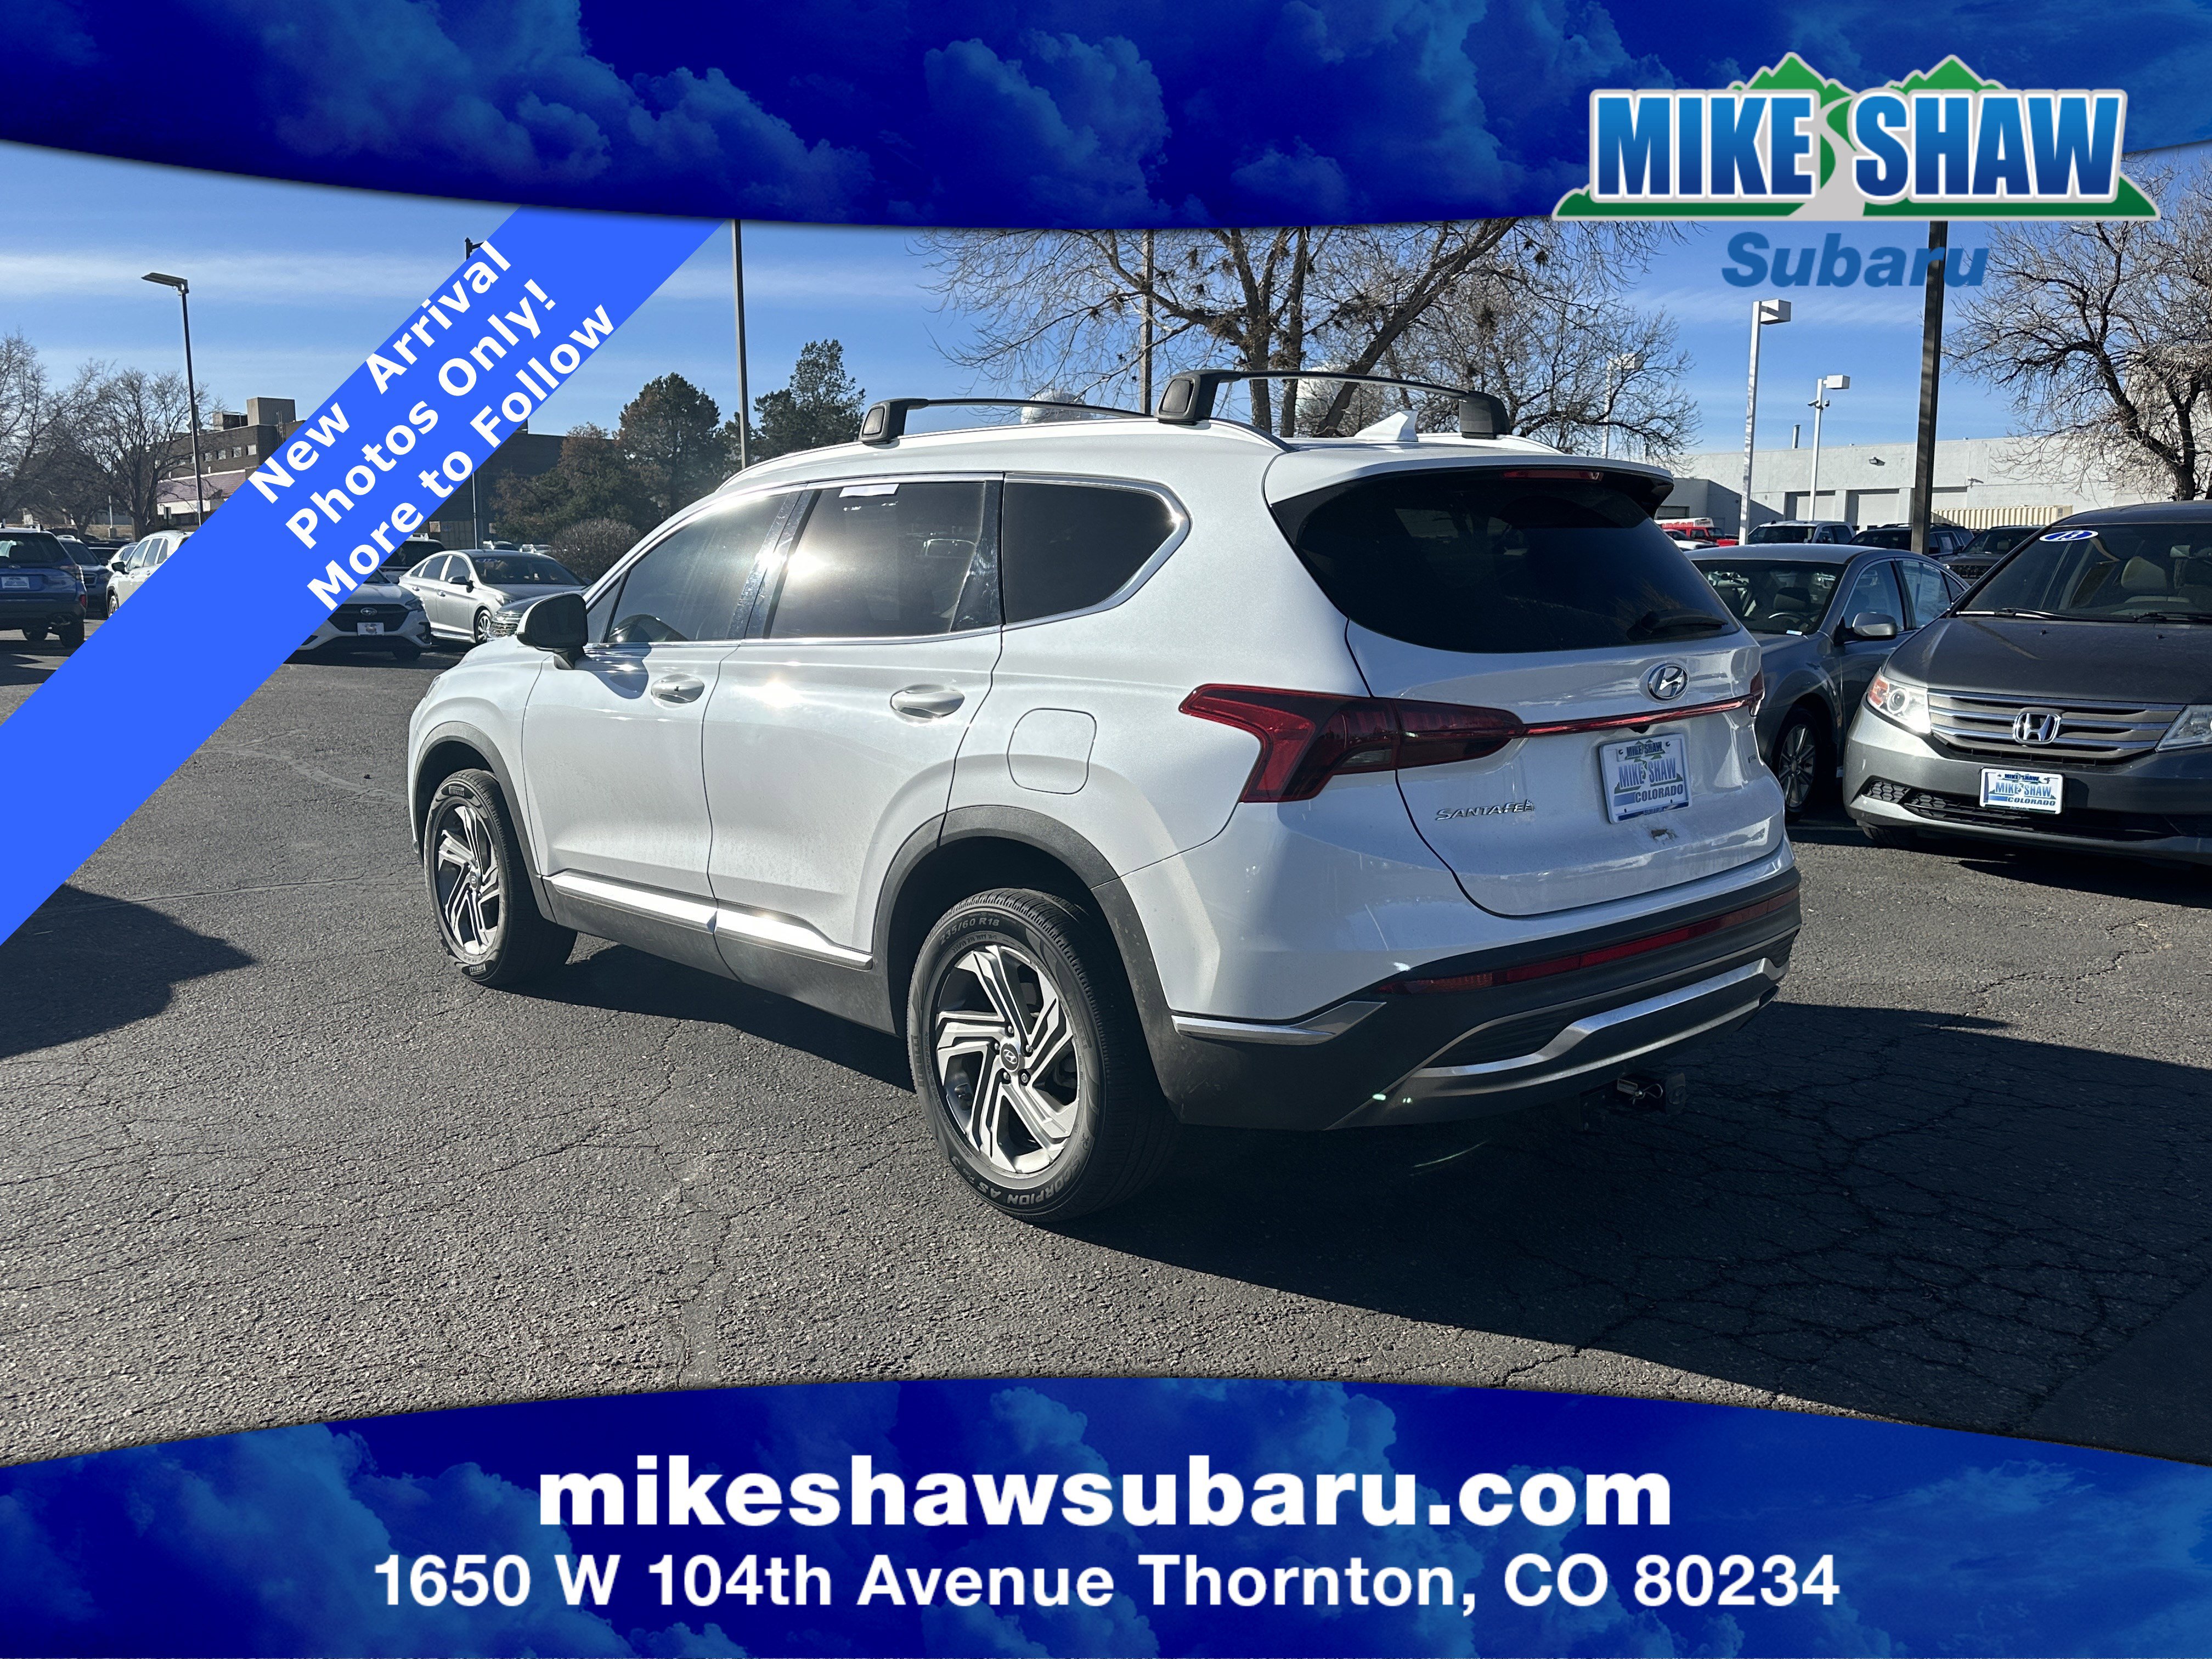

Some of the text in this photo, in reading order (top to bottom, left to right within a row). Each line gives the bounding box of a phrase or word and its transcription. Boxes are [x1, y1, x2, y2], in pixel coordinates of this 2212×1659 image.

[1627, 741, 1662, 757] MIKE SHAW
[1618, 758, 1676, 788] MIKE SHAW
[1634, 783, 1684, 803] COLORADO
[1995, 782, 2052, 797] MIKE SHAW
[2007, 797, 2056, 806] COLORADO
[940, 918, 977, 946] 235/60
[978, 917, 1000, 927] R18
[1006, 1154, 1081, 1206] SCORPION
[977, 1181, 1002, 1199] AS
